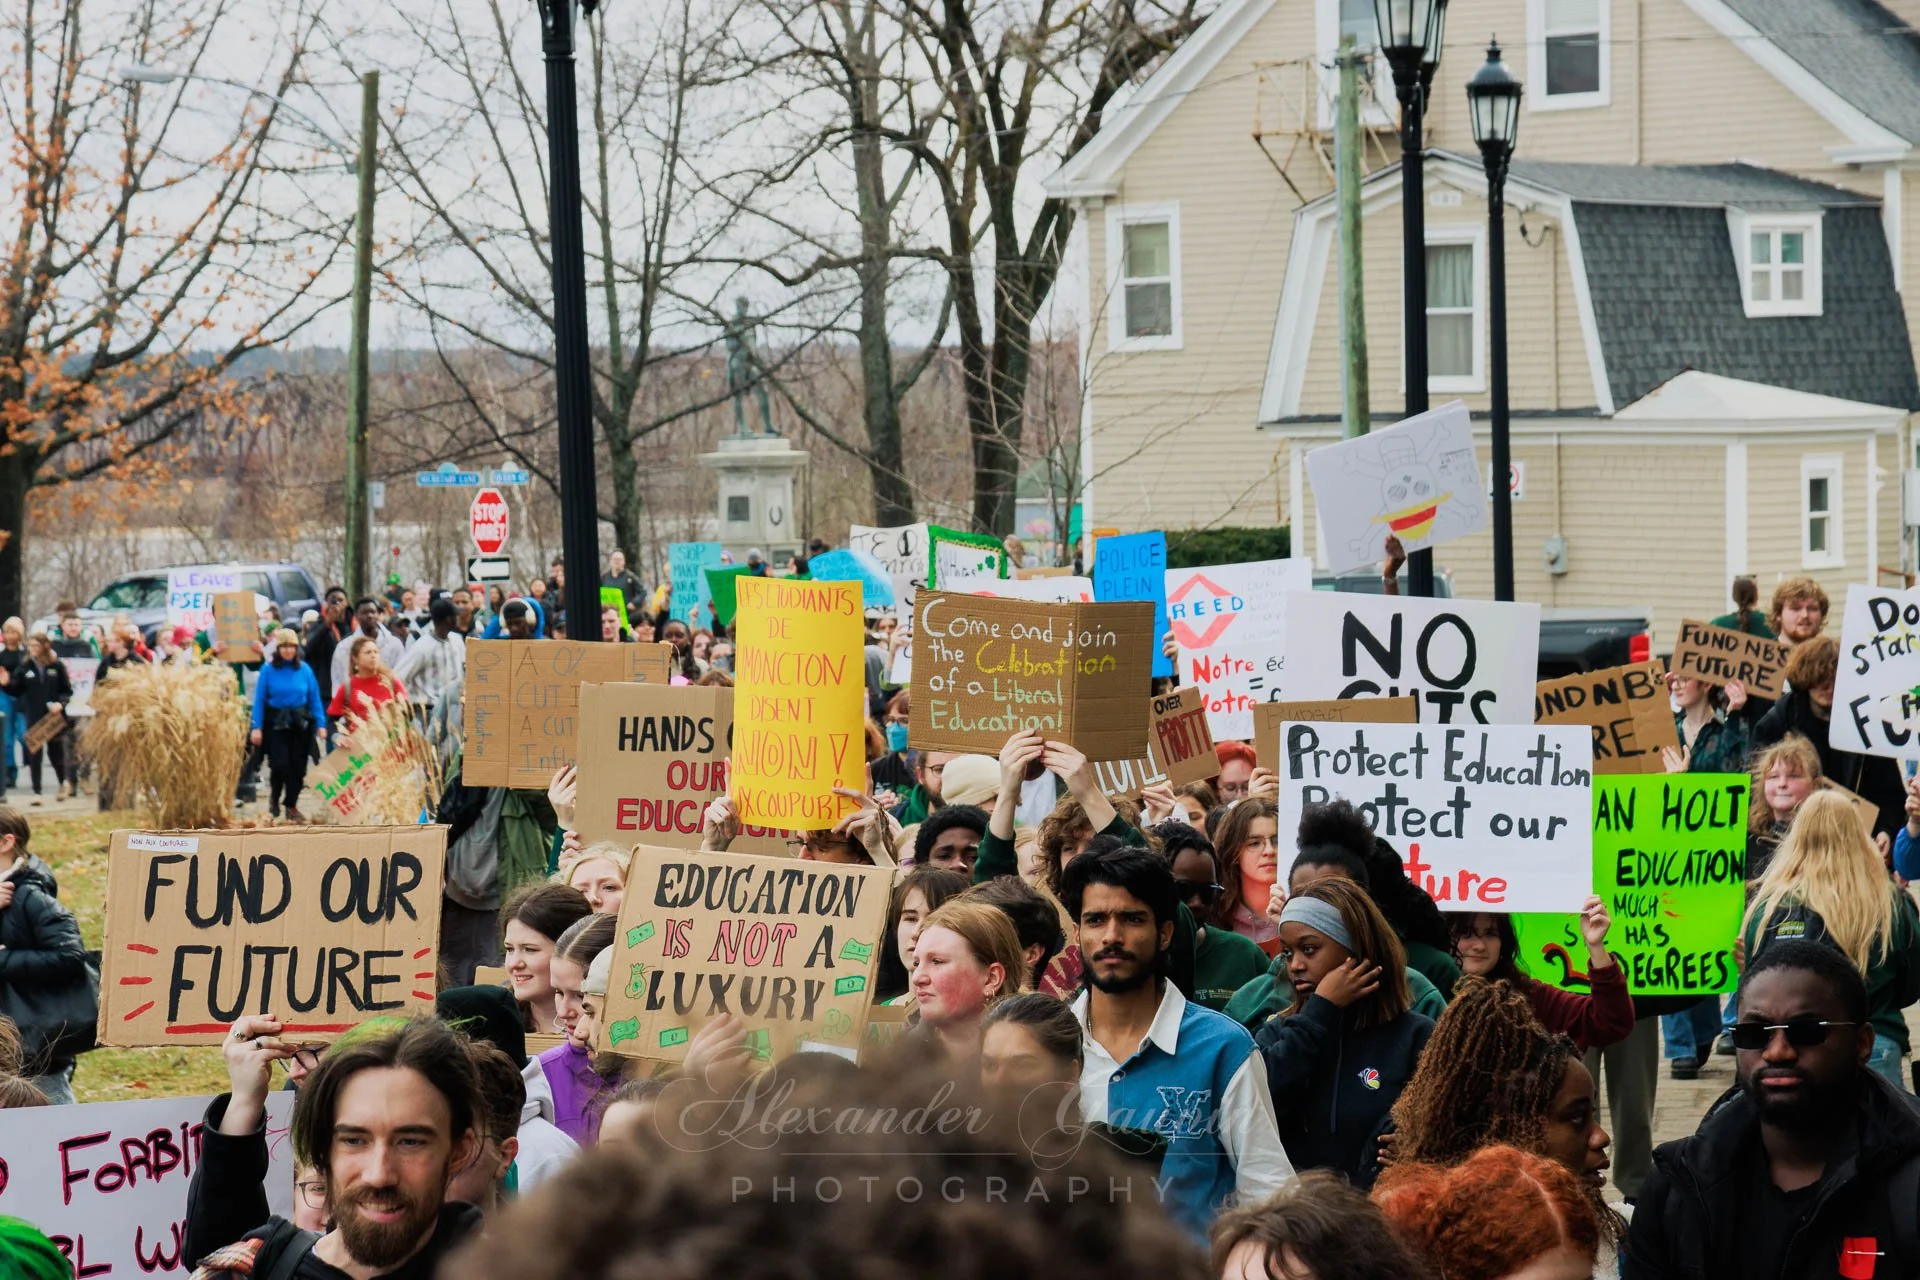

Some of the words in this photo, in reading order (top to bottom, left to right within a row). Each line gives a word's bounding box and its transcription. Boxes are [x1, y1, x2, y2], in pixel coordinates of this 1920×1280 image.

[474, 502, 507, 521] STOP
[1100, 543, 1161, 573] POLICE
[174, 572, 233, 588] LEAVE
[1103, 576, 1152, 600] PLEIN
[767, 616, 792, 640] DE
[922, 598, 1001, 638] Come
[1011, 617, 1053, 643] and
[1063, 622, 1116, 648] join
[1682, 624, 1739, 652] FUND
[515, 646, 538, 677] A
[928, 638, 965, 664] the
[975, 640, 1116, 677] Celebration
[1342, 611, 1477, 690] NO
[1192, 653, 1255, 684] Notre
[1681, 651, 1778, 692] FUTURE
[516, 682, 562, 709] CUT
[929, 667, 960, 693] of
[967, 681, 984, 695] a
[993, 678, 1063, 706] Liberal
[1336, 680, 1497, 724] TS
[750, 696, 816, 724] DISENT
[930, 700, 1063, 733] Education!
[1154, 694, 1183, 715] OVER
[519, 715, 533, 737] A
[543, 716, 574, 737] CUT
[618, 715, 715, 753] HANDS
[1287, 725, 1429, 779] Protect
[1444, 729, 1591, 788] Education
[667, 760, 726, 791] OUR
[1662, 782, 1746, 832] HOLT
[1489, 813, 1568, 841] our
[1616, 848, 1745, 888] EDUCATION
[144, 852, 292, 929] FUND
[320, 852, 423, 923] OUR
[653, 863, 866, 918] EDUCATION
[1613, 892, 1660, 918] MUCH
[662, 918, 694, 959] IS
[707, 919, 798, 967] NOT
[804, 925, 835, 969] A
[1625, 922, 1671, 947] HAS
[166, 944, 405, 1022] FUTURE
[645, 970, 826, 1021] LUXURY
